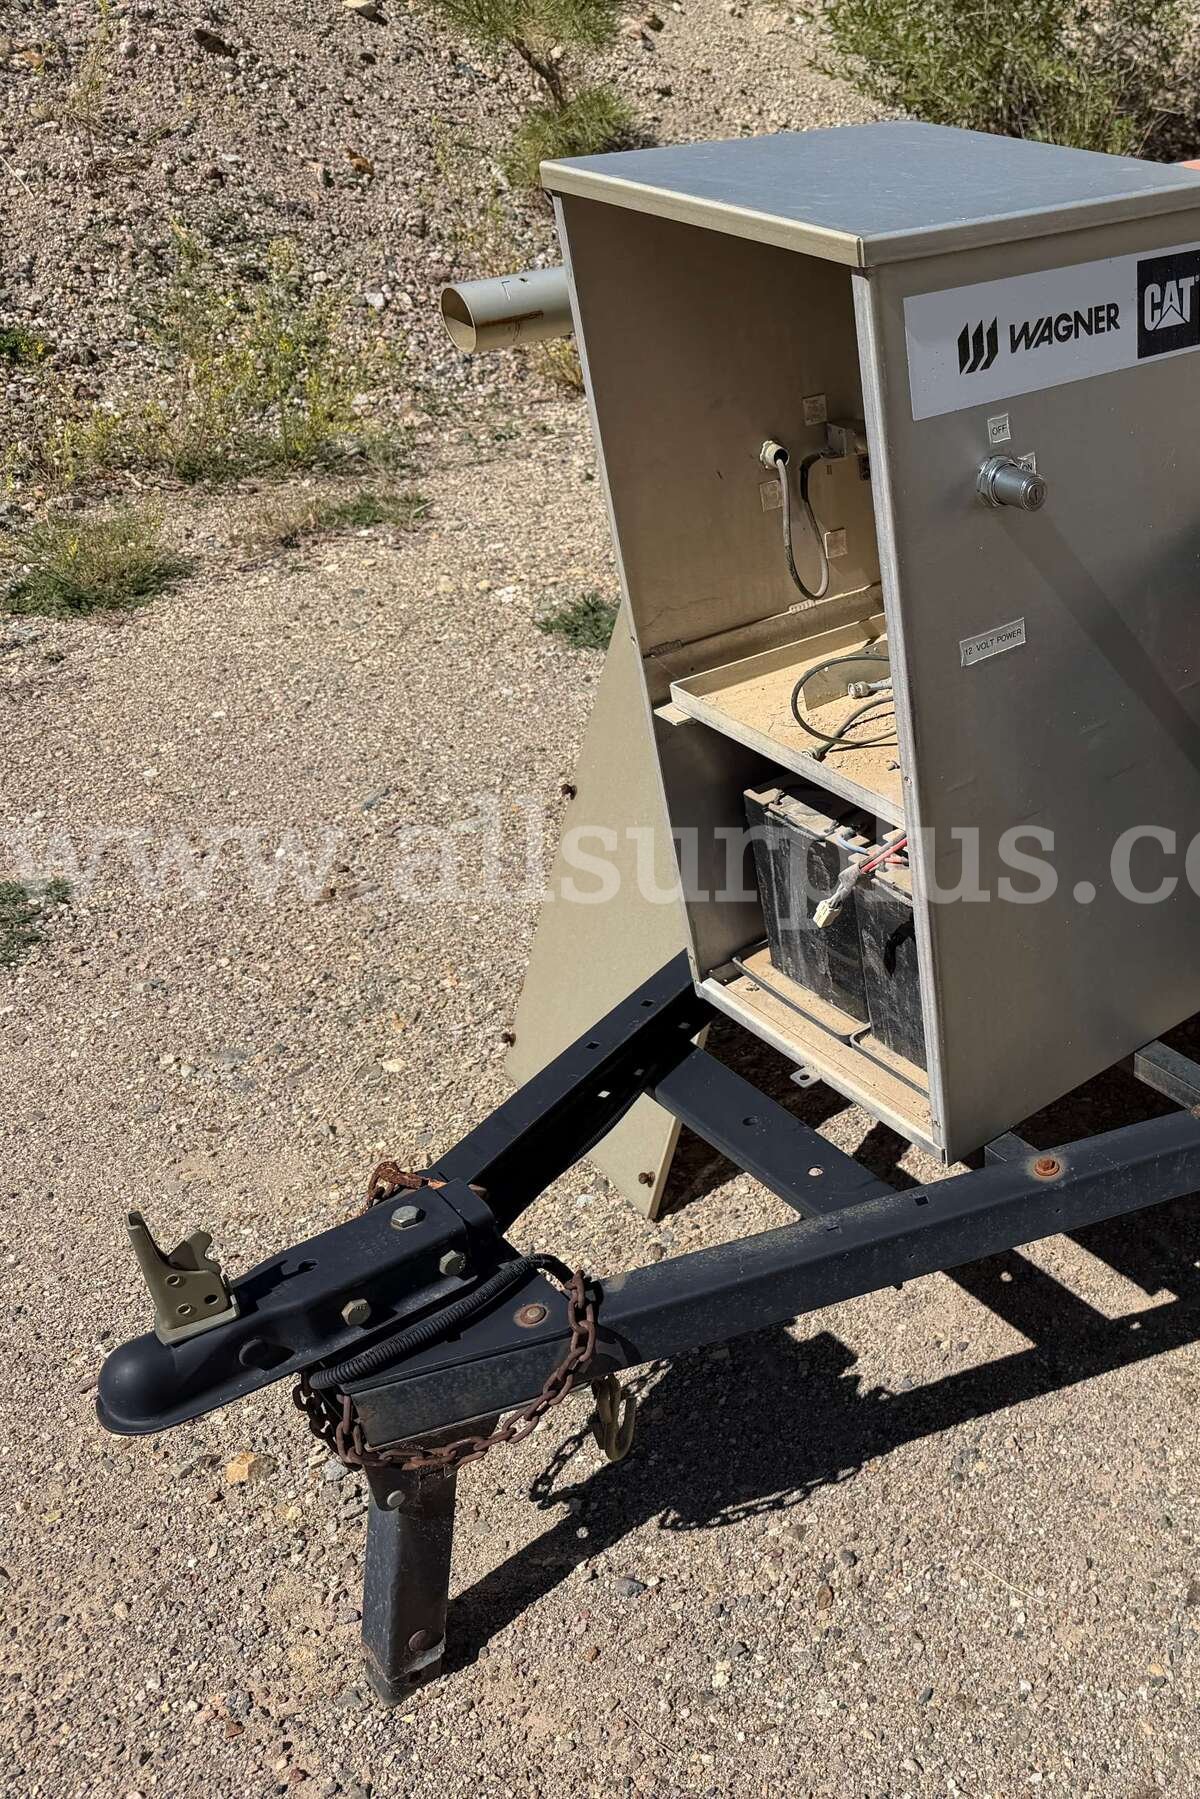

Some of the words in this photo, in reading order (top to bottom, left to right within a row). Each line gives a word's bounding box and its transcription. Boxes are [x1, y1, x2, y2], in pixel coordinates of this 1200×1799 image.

[1009, 303, 1120, 353] WAGNER
[1144, 276, 1194, 331] CAT
[991, 424, 1007, 435] OFF
[965, 647, 973, 656] 12
[977, 639, 994, 651] VOLT
[997, 629, 1021, 642] POWER
